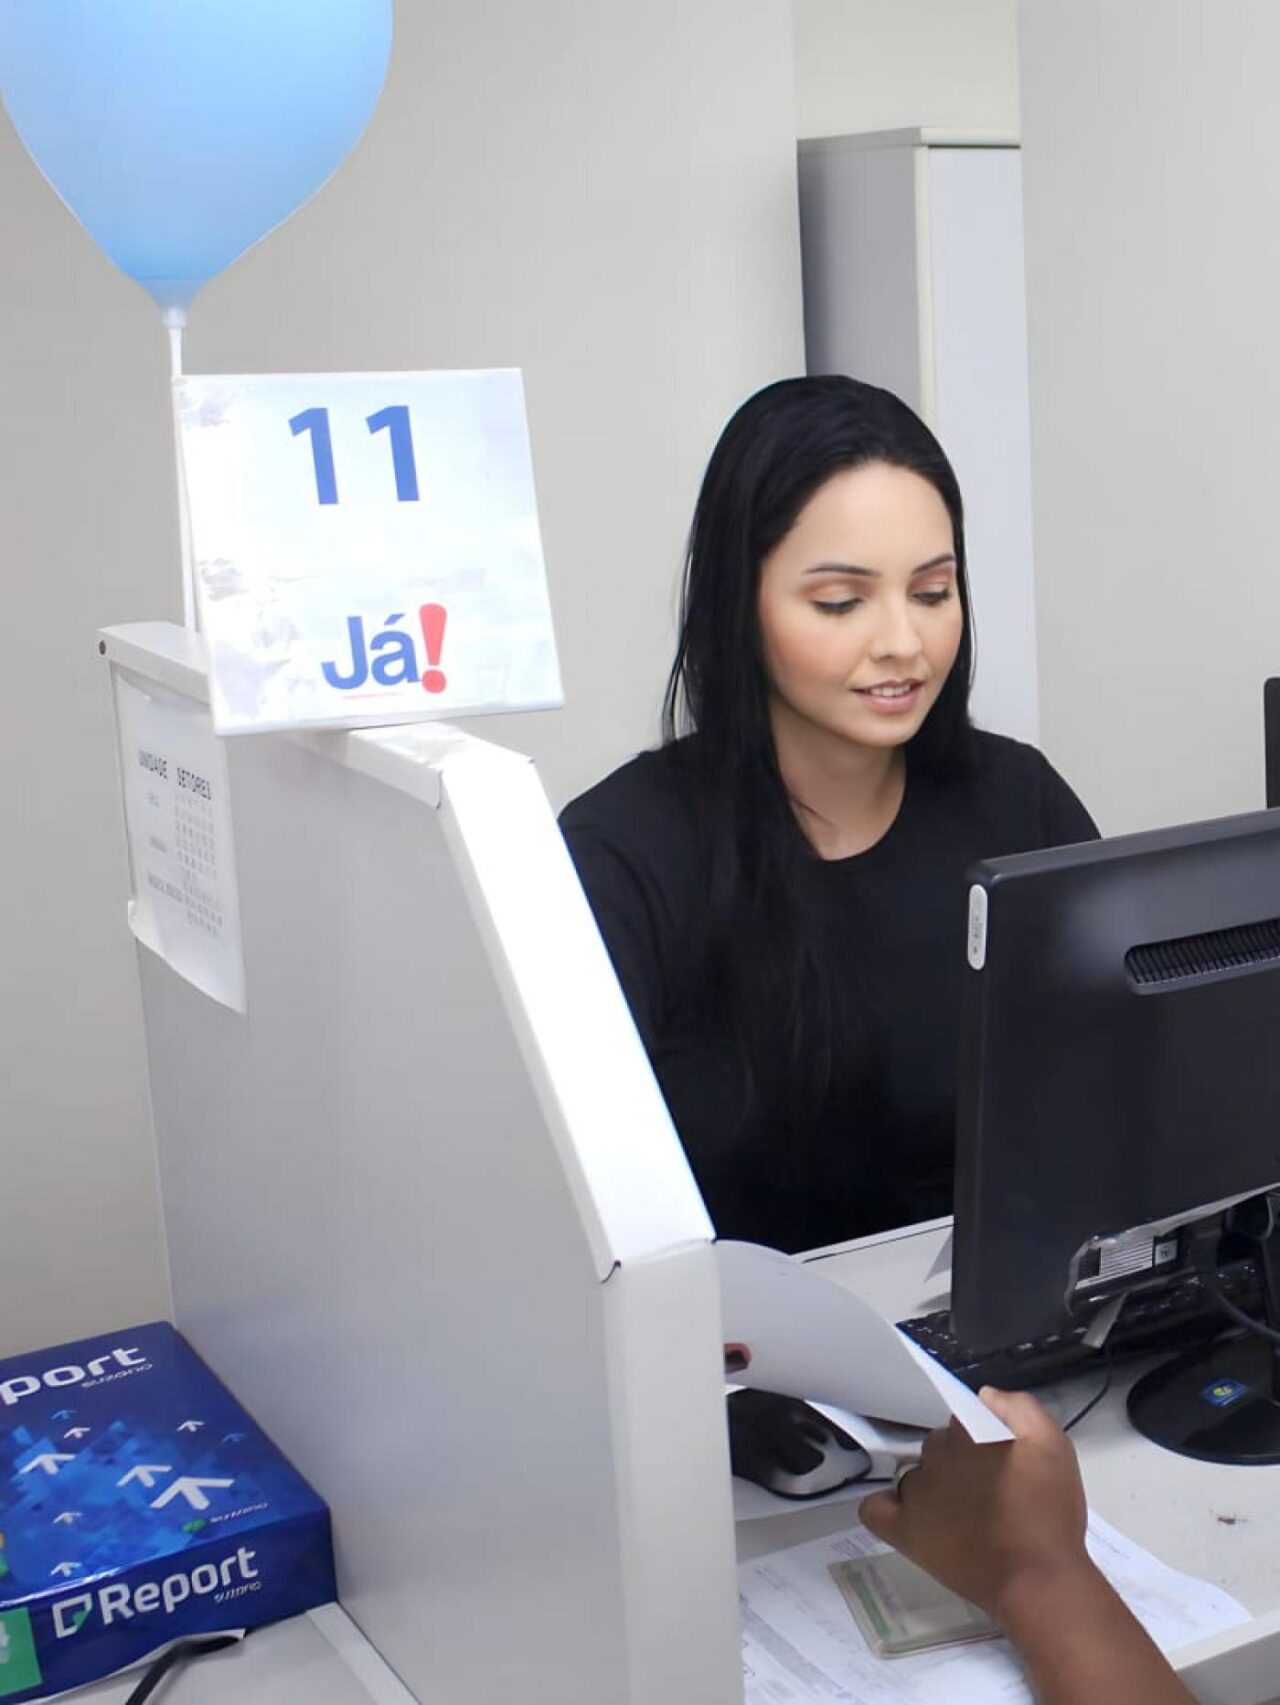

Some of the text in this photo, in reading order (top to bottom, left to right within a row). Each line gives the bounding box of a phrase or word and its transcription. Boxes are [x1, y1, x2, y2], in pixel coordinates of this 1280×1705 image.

[321, 603, 447, 693] Já!
[0, 1346, 146, 1405] port
[100, 1547, 258, 1625] Report
